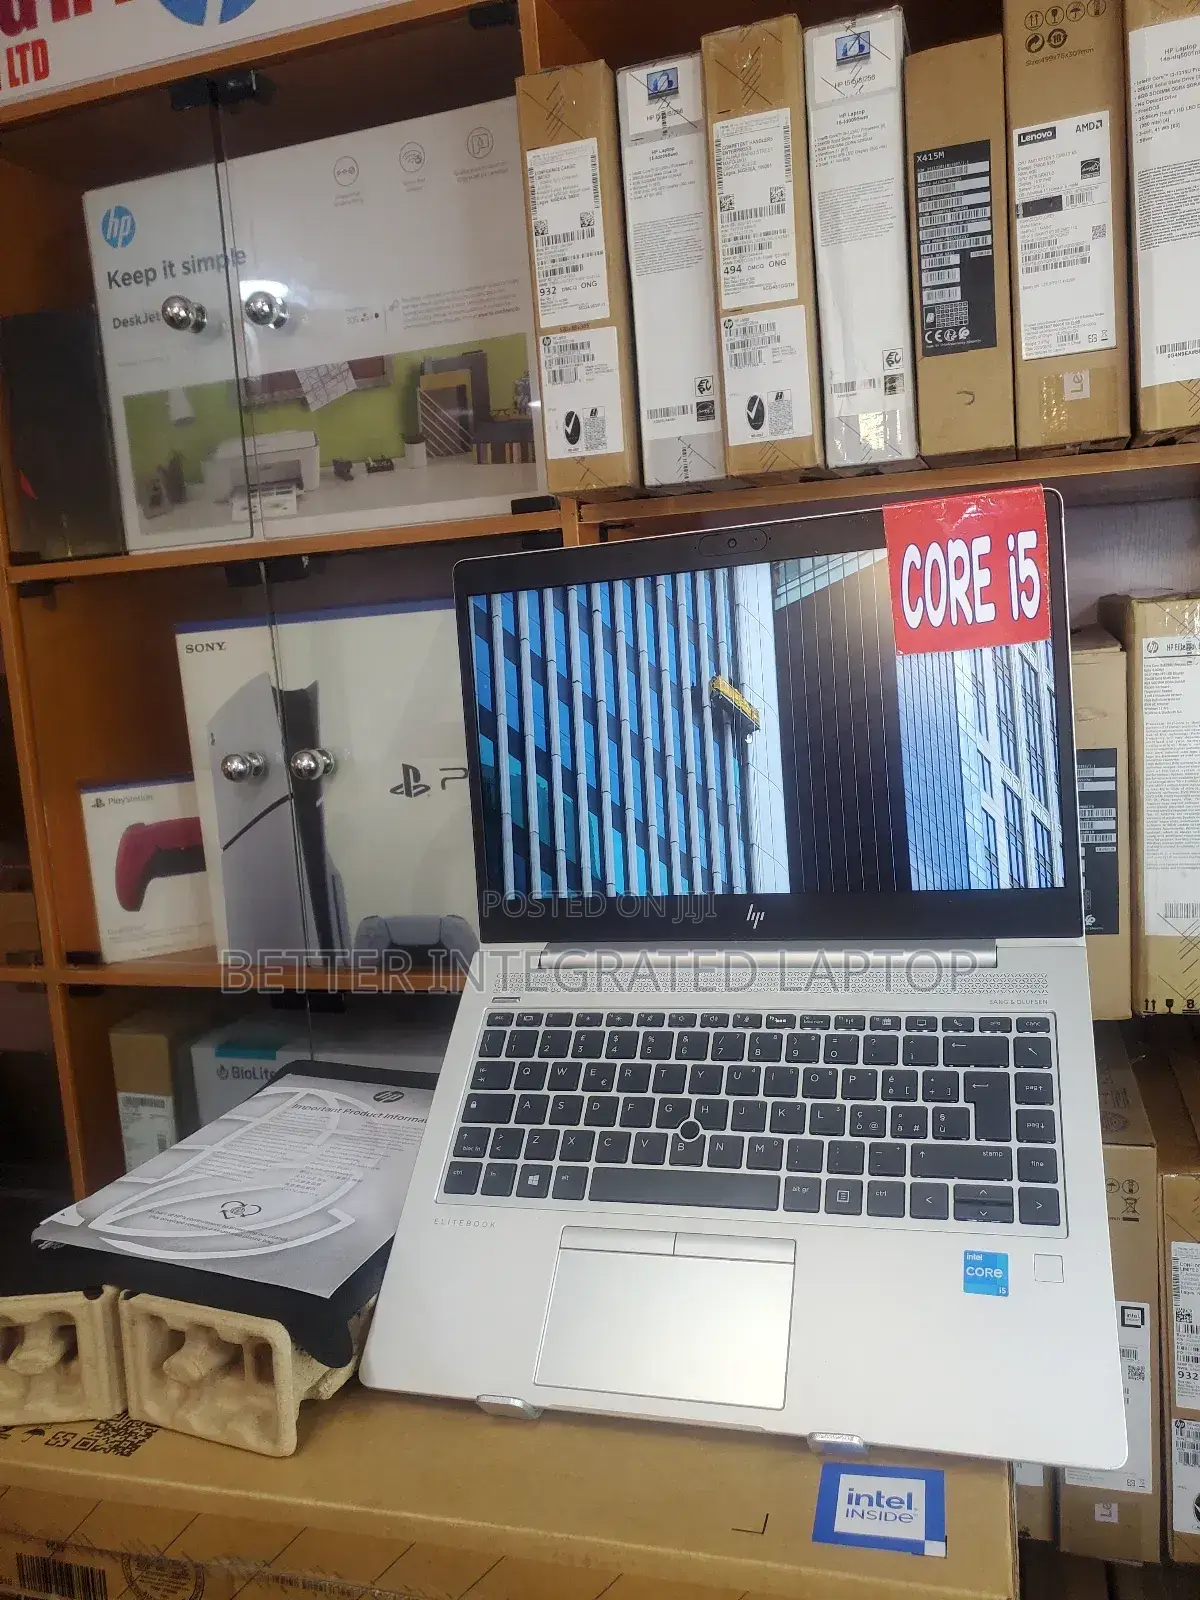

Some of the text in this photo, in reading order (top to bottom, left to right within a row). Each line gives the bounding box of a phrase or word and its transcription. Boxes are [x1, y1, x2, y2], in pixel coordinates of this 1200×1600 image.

[1164, 43, 1197, 55] HP Laptop
[6, 38, 50, 88] LTD
[1146, 96, 1163, 105] Optical
[848, 109, 866, 118] Laptop
[1076, 121, 1096, 133] AMD
[1021, 130, 1053, 143] Lenovo
[917, 151, 944, 163] X415M
[102, 205, 136, 249] hp
[107, 249, 247, 290] Keep it simple
[724, 265, 742, 275] 494
[769, 259, 786, 268] ONG
[540, 286, 557, 297] 932
[581, 281, 598, 289] ONG
[112, 311, 161, 330] DeskJet
[901, 530, 1041, 630] CORE i5
[185, 641, 227, 655] SONY
[108, 793, 155, 806] PlayStation
[746, 903, 765, 930] hp
[292, 1103, 343, 1115] Important
[343, 1108, 384, 1120] Product
[982, 1150, 1004, 1158] stamp
[434, 1217, 497, 1229] ELITEBOOK
[966, 1253, 984, 1262] intel
[1177, 1370, 1198, 1381] 932
[847, 1487, 914, 1512] intel
